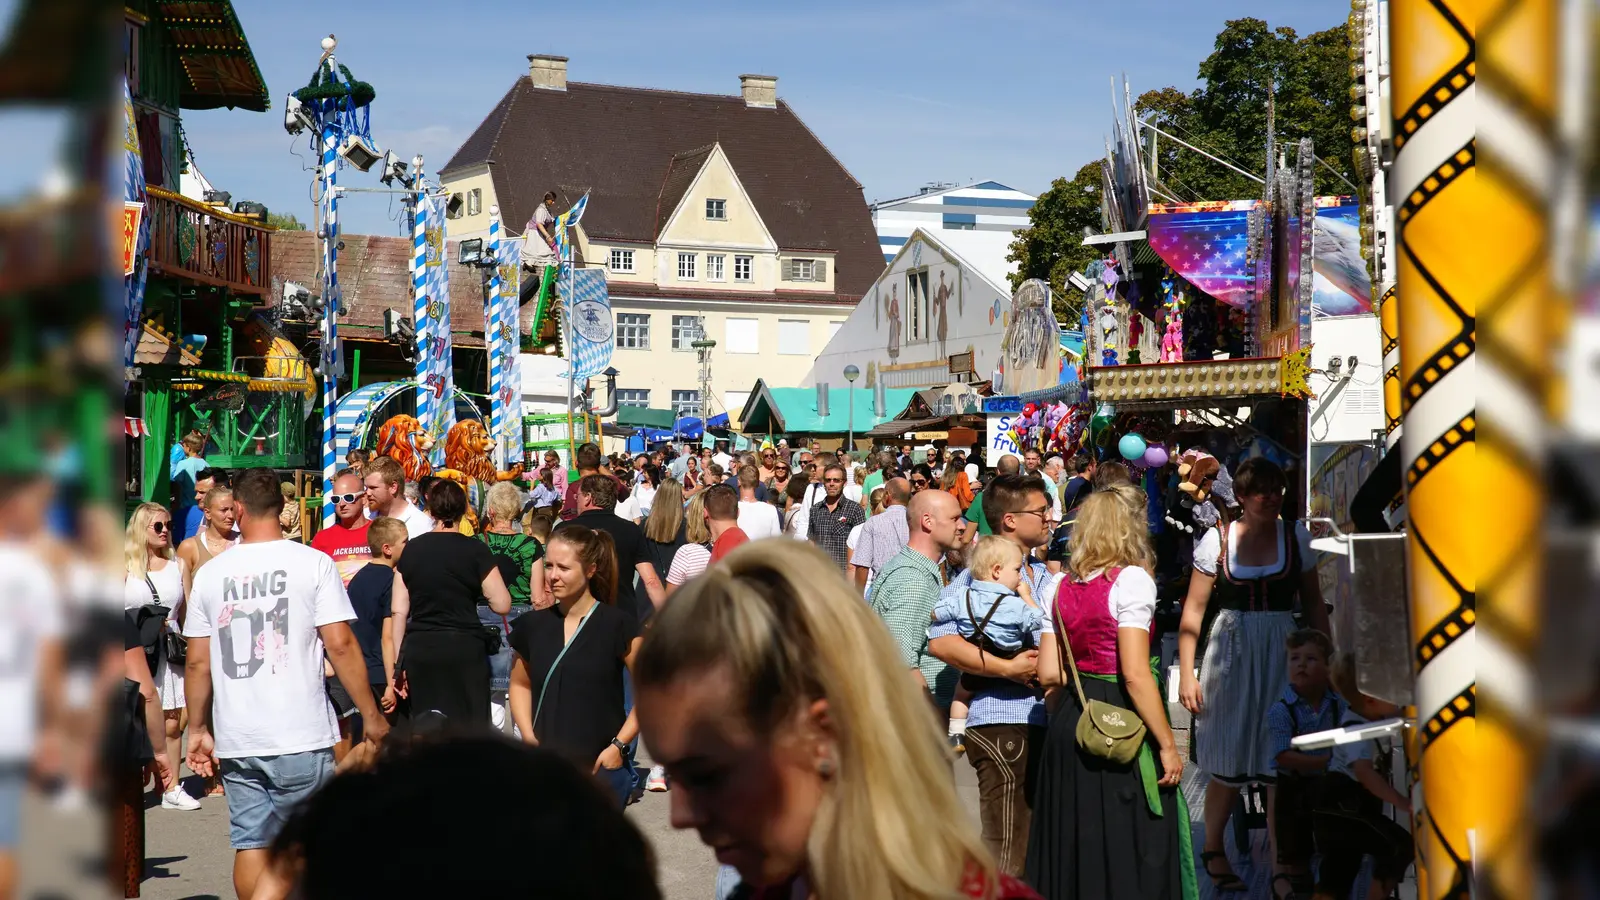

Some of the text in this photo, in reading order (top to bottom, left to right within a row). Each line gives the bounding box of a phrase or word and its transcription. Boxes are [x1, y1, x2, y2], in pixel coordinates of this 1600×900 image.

[333, 546, 372, 556] JACK&JONES
[223, 569, 287, 602] KING
[218, 597, 289, 680] 01
